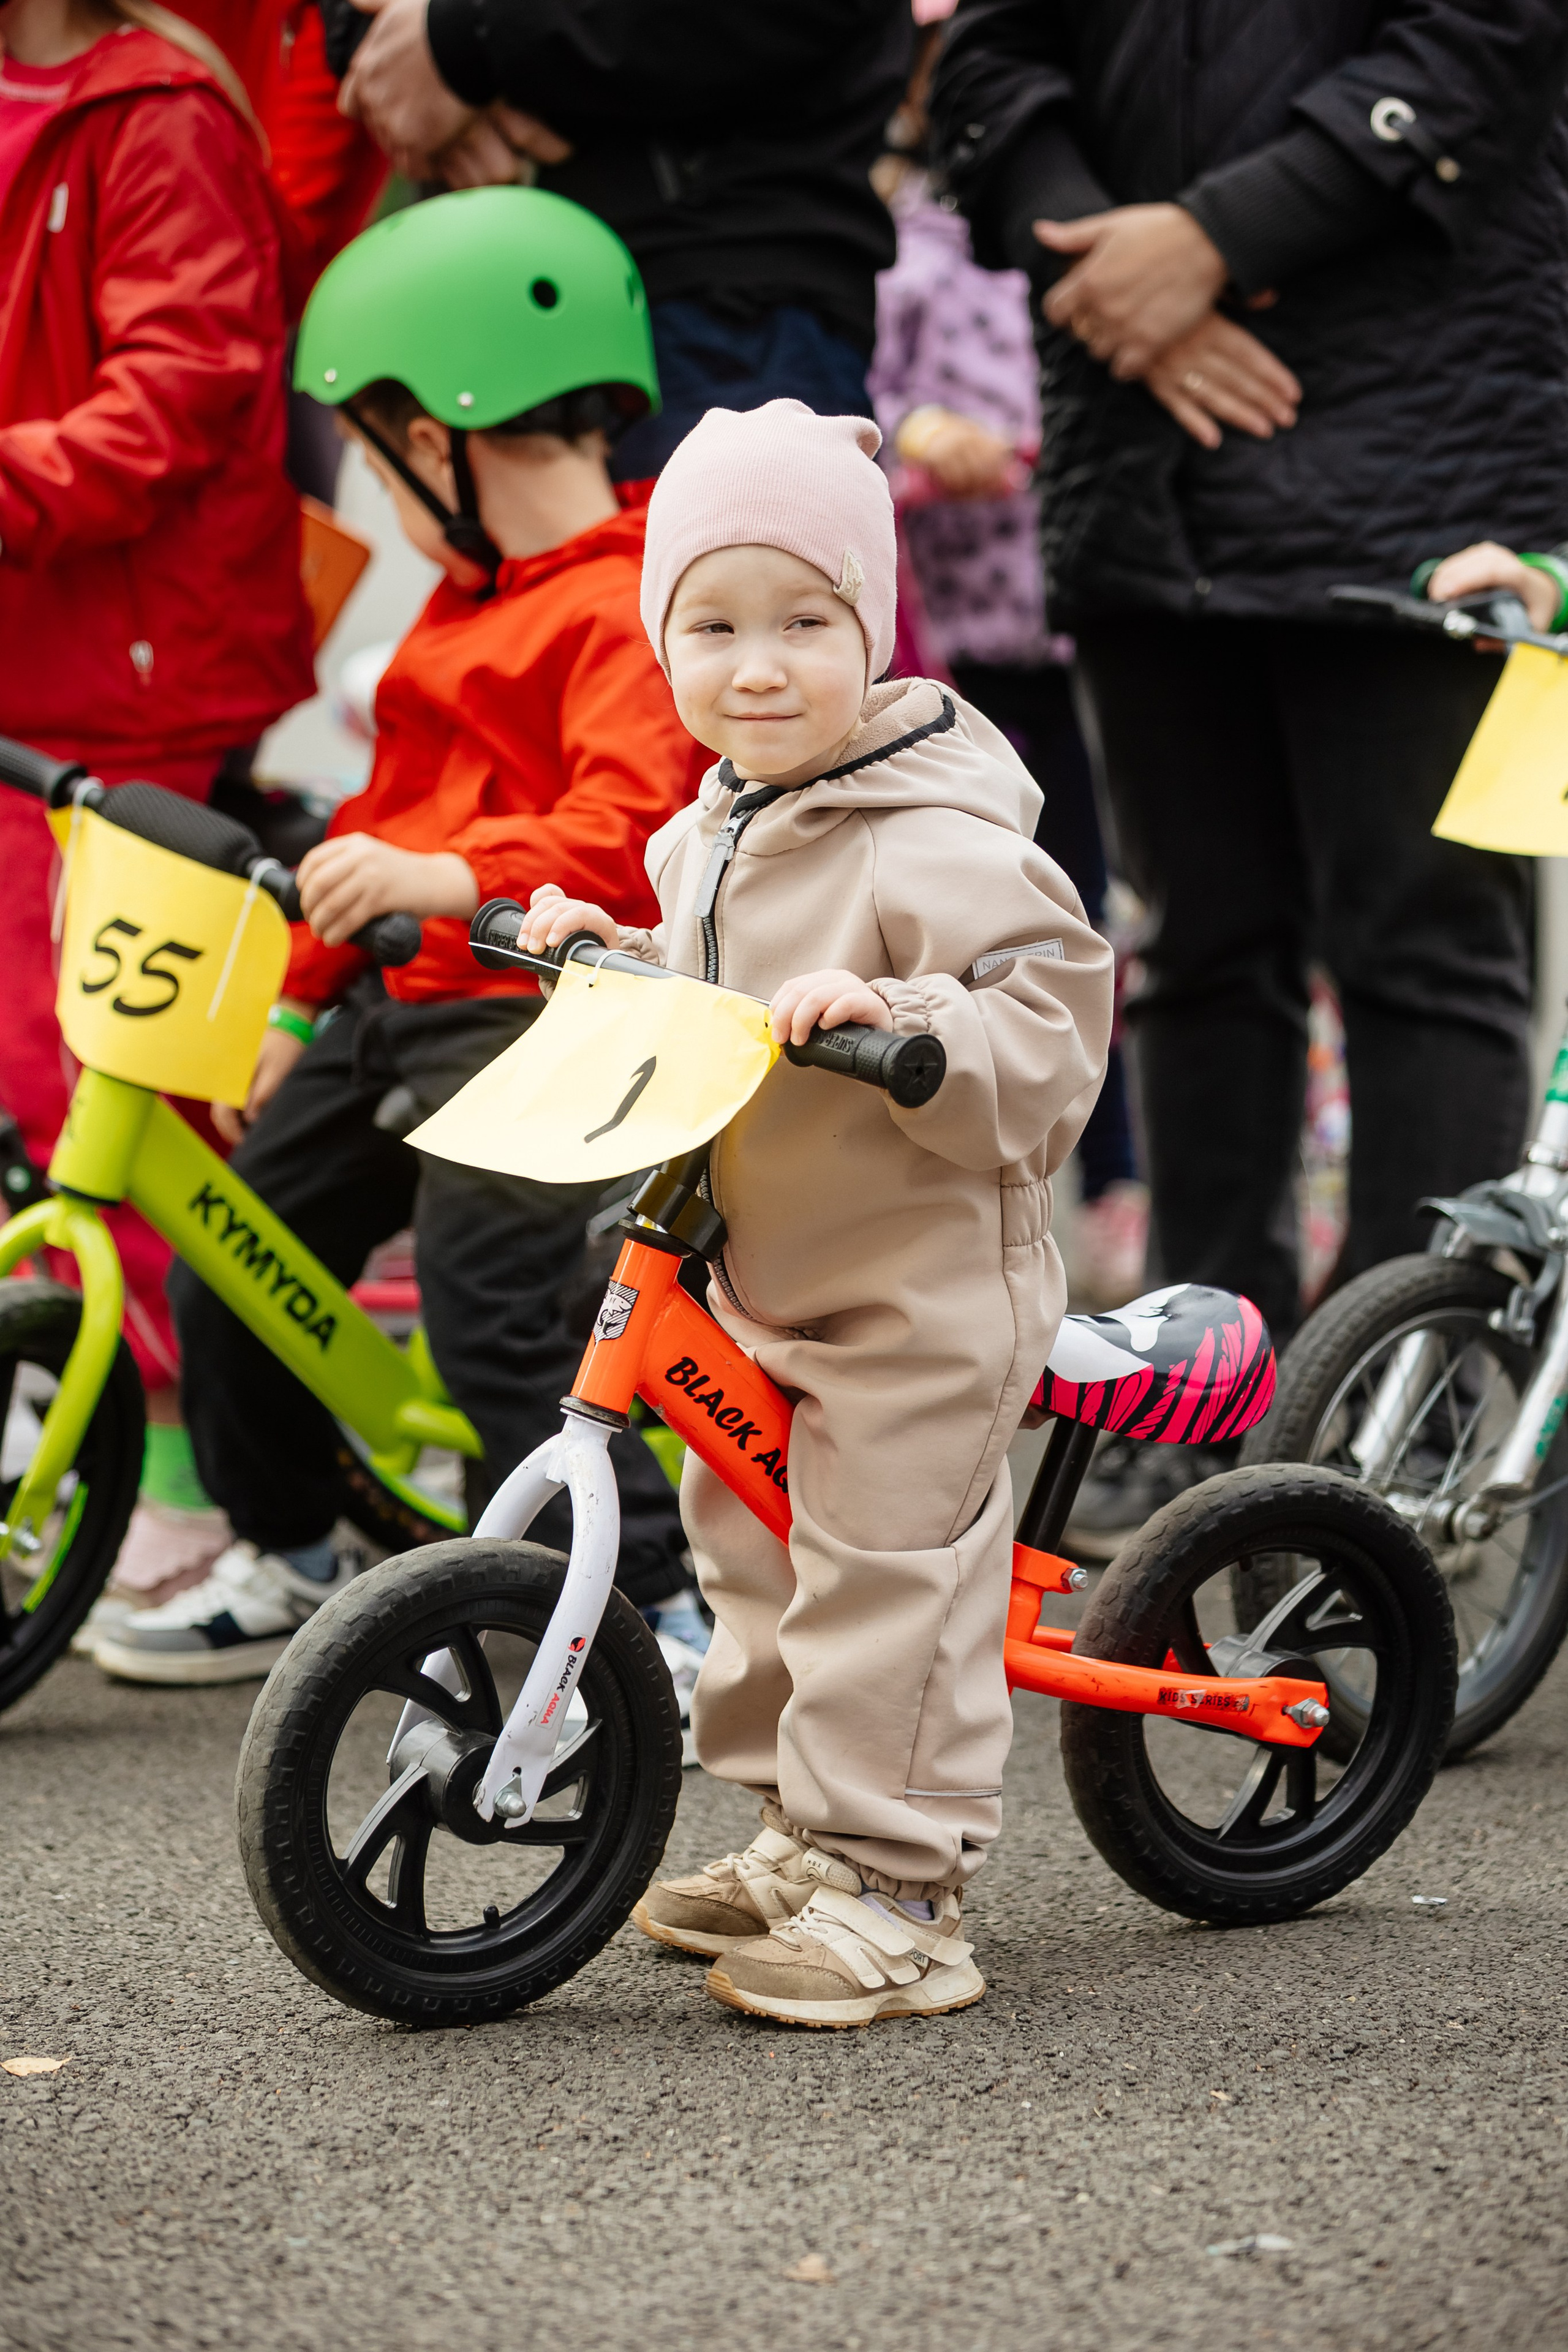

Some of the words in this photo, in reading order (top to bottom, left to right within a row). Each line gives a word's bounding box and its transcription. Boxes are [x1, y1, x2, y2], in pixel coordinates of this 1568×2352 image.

[80, 918, 204, 1017] 55
[584, 1055, 657, 1144] 1
[187, 1182, 336, 1352] KYMYDA
[664, 1356, 763, 1451] BLACK
[540, 1692, 560, 1724] AQUA
[556, 1654, 577, 1692] BLACK
[1159, 1691, 1186, 1703] KIDS
